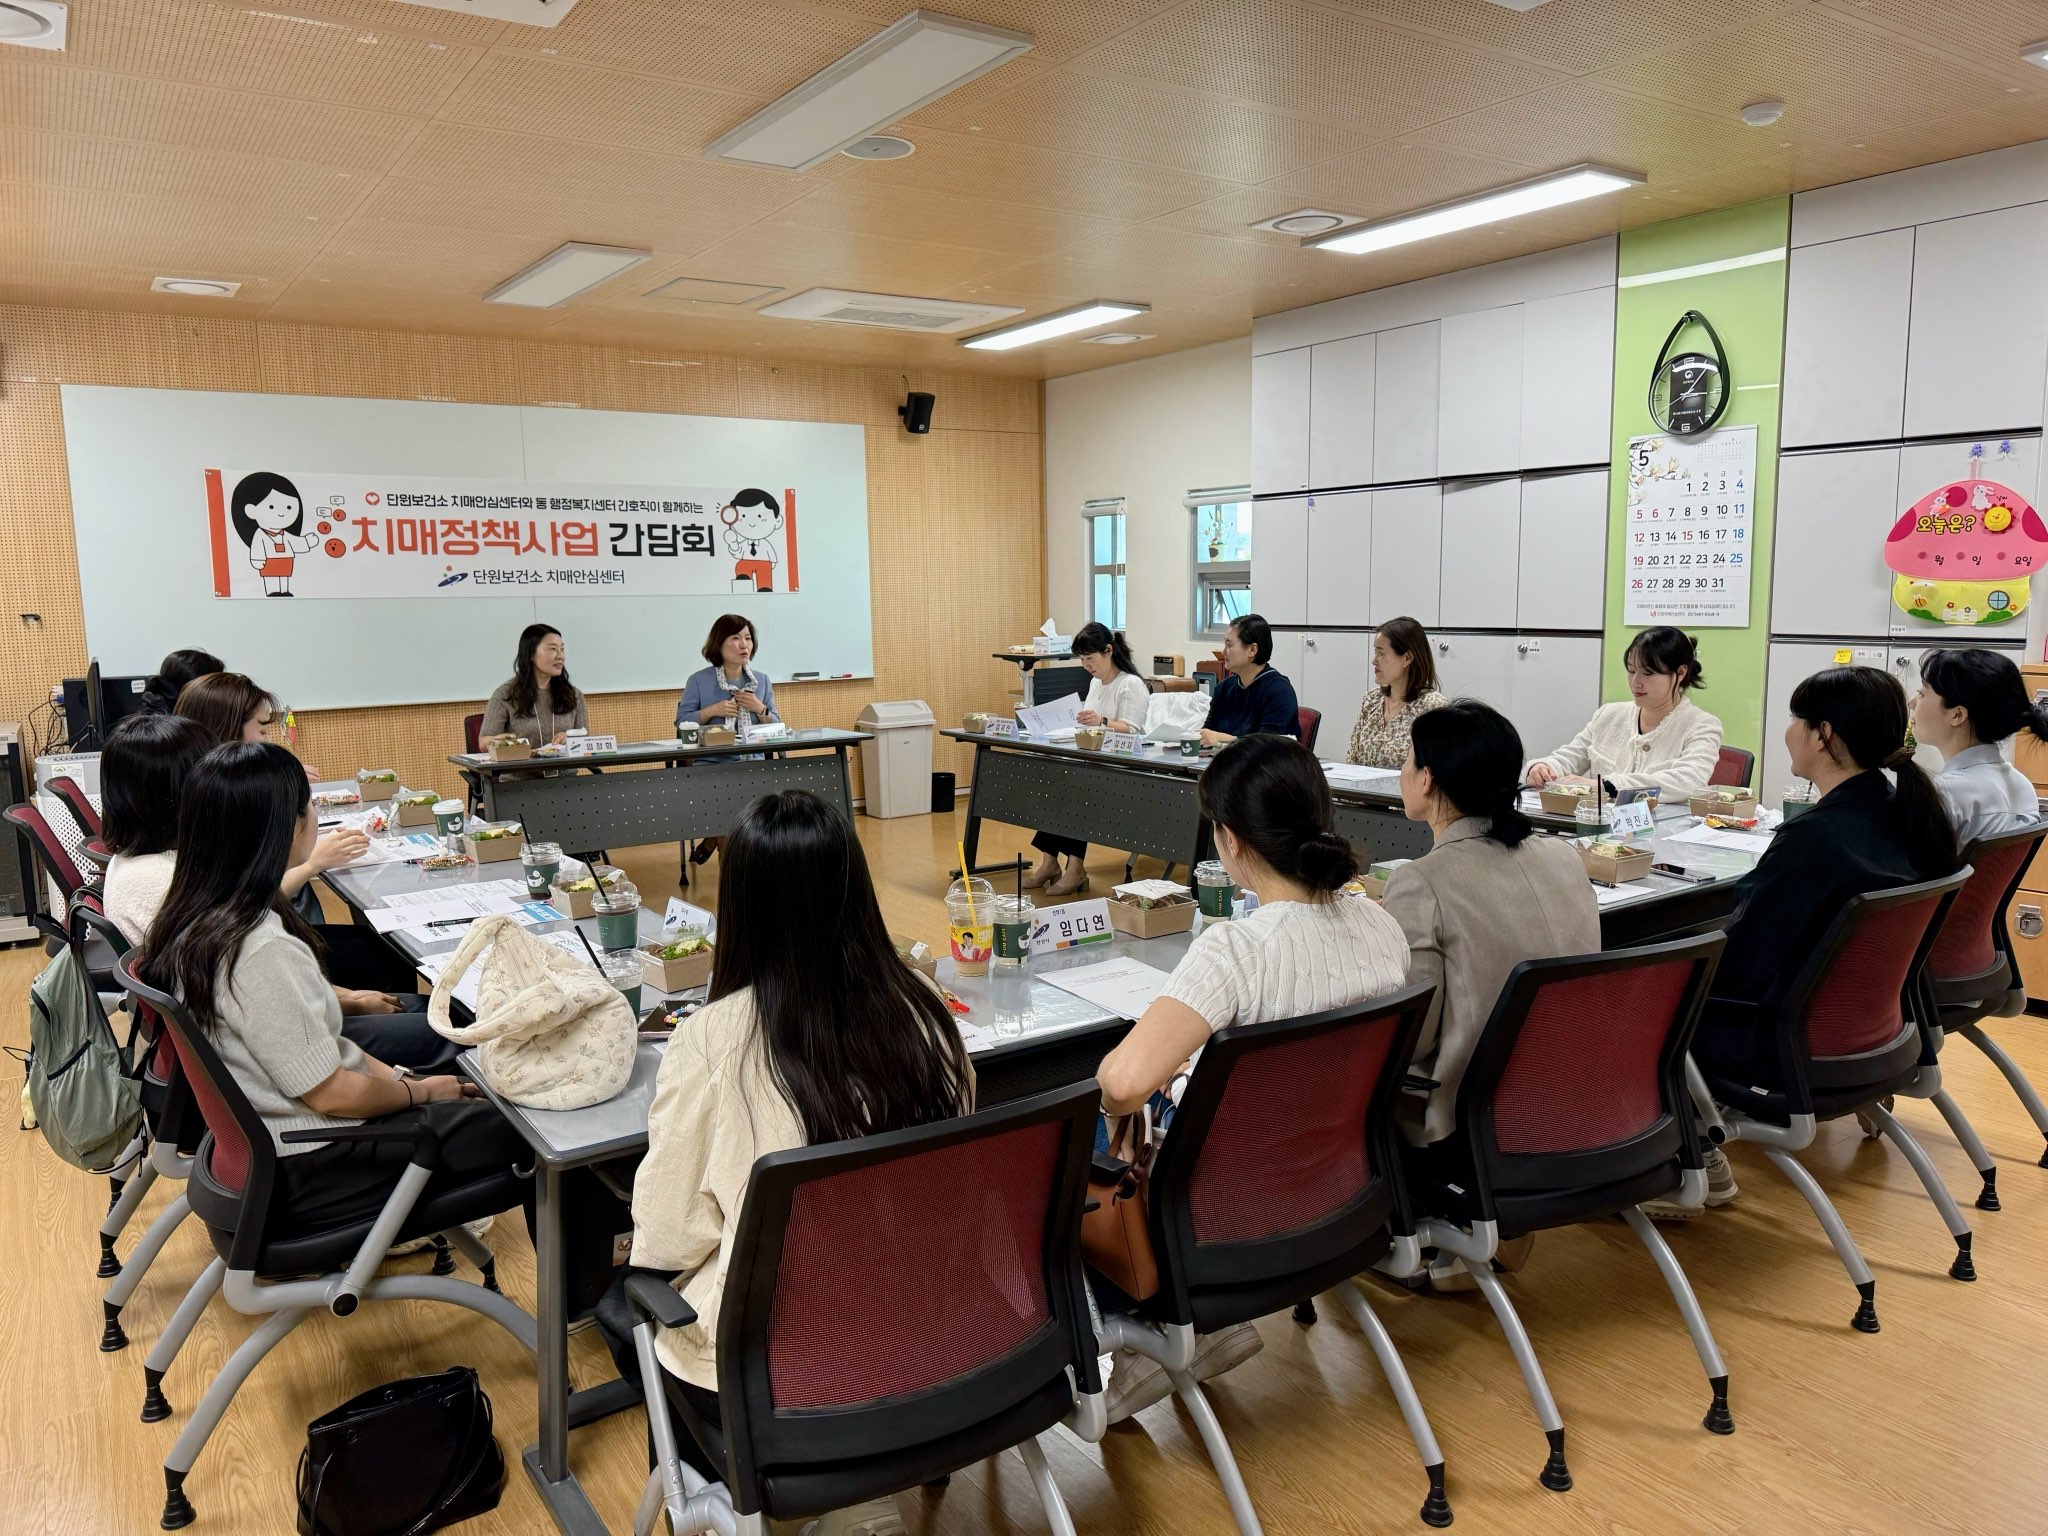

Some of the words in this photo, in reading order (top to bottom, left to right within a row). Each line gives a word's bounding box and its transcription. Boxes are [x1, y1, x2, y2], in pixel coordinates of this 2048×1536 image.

[1639, 450, 1649, 466] 5
[1686, 483, 1691, 493] 1
[1702, 481, 1709, 492] 2
[1719, 480, 1726, 491] 3
[1736, 478, 1744, 489] 4
[386, 493, 449, 508] 단원보건소
[451, 494, 534, 510] 치매안심센터와
[536, 497, 547, 510] 동
[550, 497, 616, 512] 행정복지센터
[617, 499, 661, 513] 간호직이
[662, 501, 704, 514] 함께하는
[1636, 509, 1643, 519] 5
[1652, 508, 1659, 519] 6
[1668, 507, 1675, 518] 7
[1684, 506, 1691, 517] 8
[1701, 505, 1708, 516] 9
[1716, 504, 1728, 515] 10
[1733, 503, 1745, 514] 11
[1916, 514, 1977, 535] 오늘은?
[352, 516, 599, 557] 치매정책사업
[609, 522, 716, 557] 간담회
[1634, 533, 1645, 543] 12
[1649, 532, 1661, 542] 13
[1665, 531, 1677, 542] 14
[1682, 531, 1693, 541] 15
[1698, 530, 1710, 540] 16
[1715, 530, 1727, 540] 17
[1732, 528, 1745, 539] 18
[1633, 556, 1644, 566] 19
[1647, 556, 1660, 566] 20
[1663, 555, 1675, 565] 21
[1679, 555, 1692, 565] 22
[1695, 554, 1708, 564] 23
[1712, 553, 1726, 564] 24
[1729, 553, 1743, 564] 25
[1934, 554, 1945, 566] 월
[1972, 554, 1983, 566] 일
[2014, 555, 2033, 567] 요일
[473, 569, 544, 585] 단원보건소
[546, 569, 625, 585] 치매안심센터
[1631, 579, 1643, 589] 26
[1646, 579, 1659, 589] 27
[1662, 579, 1674, 589] 28
[1678, 578, 1691, 589] 29
[1694, 578, 1708, 588] 30
[1711, 578, 1724, 588] 31
[1059, 914, 1105, 937] 임다연
